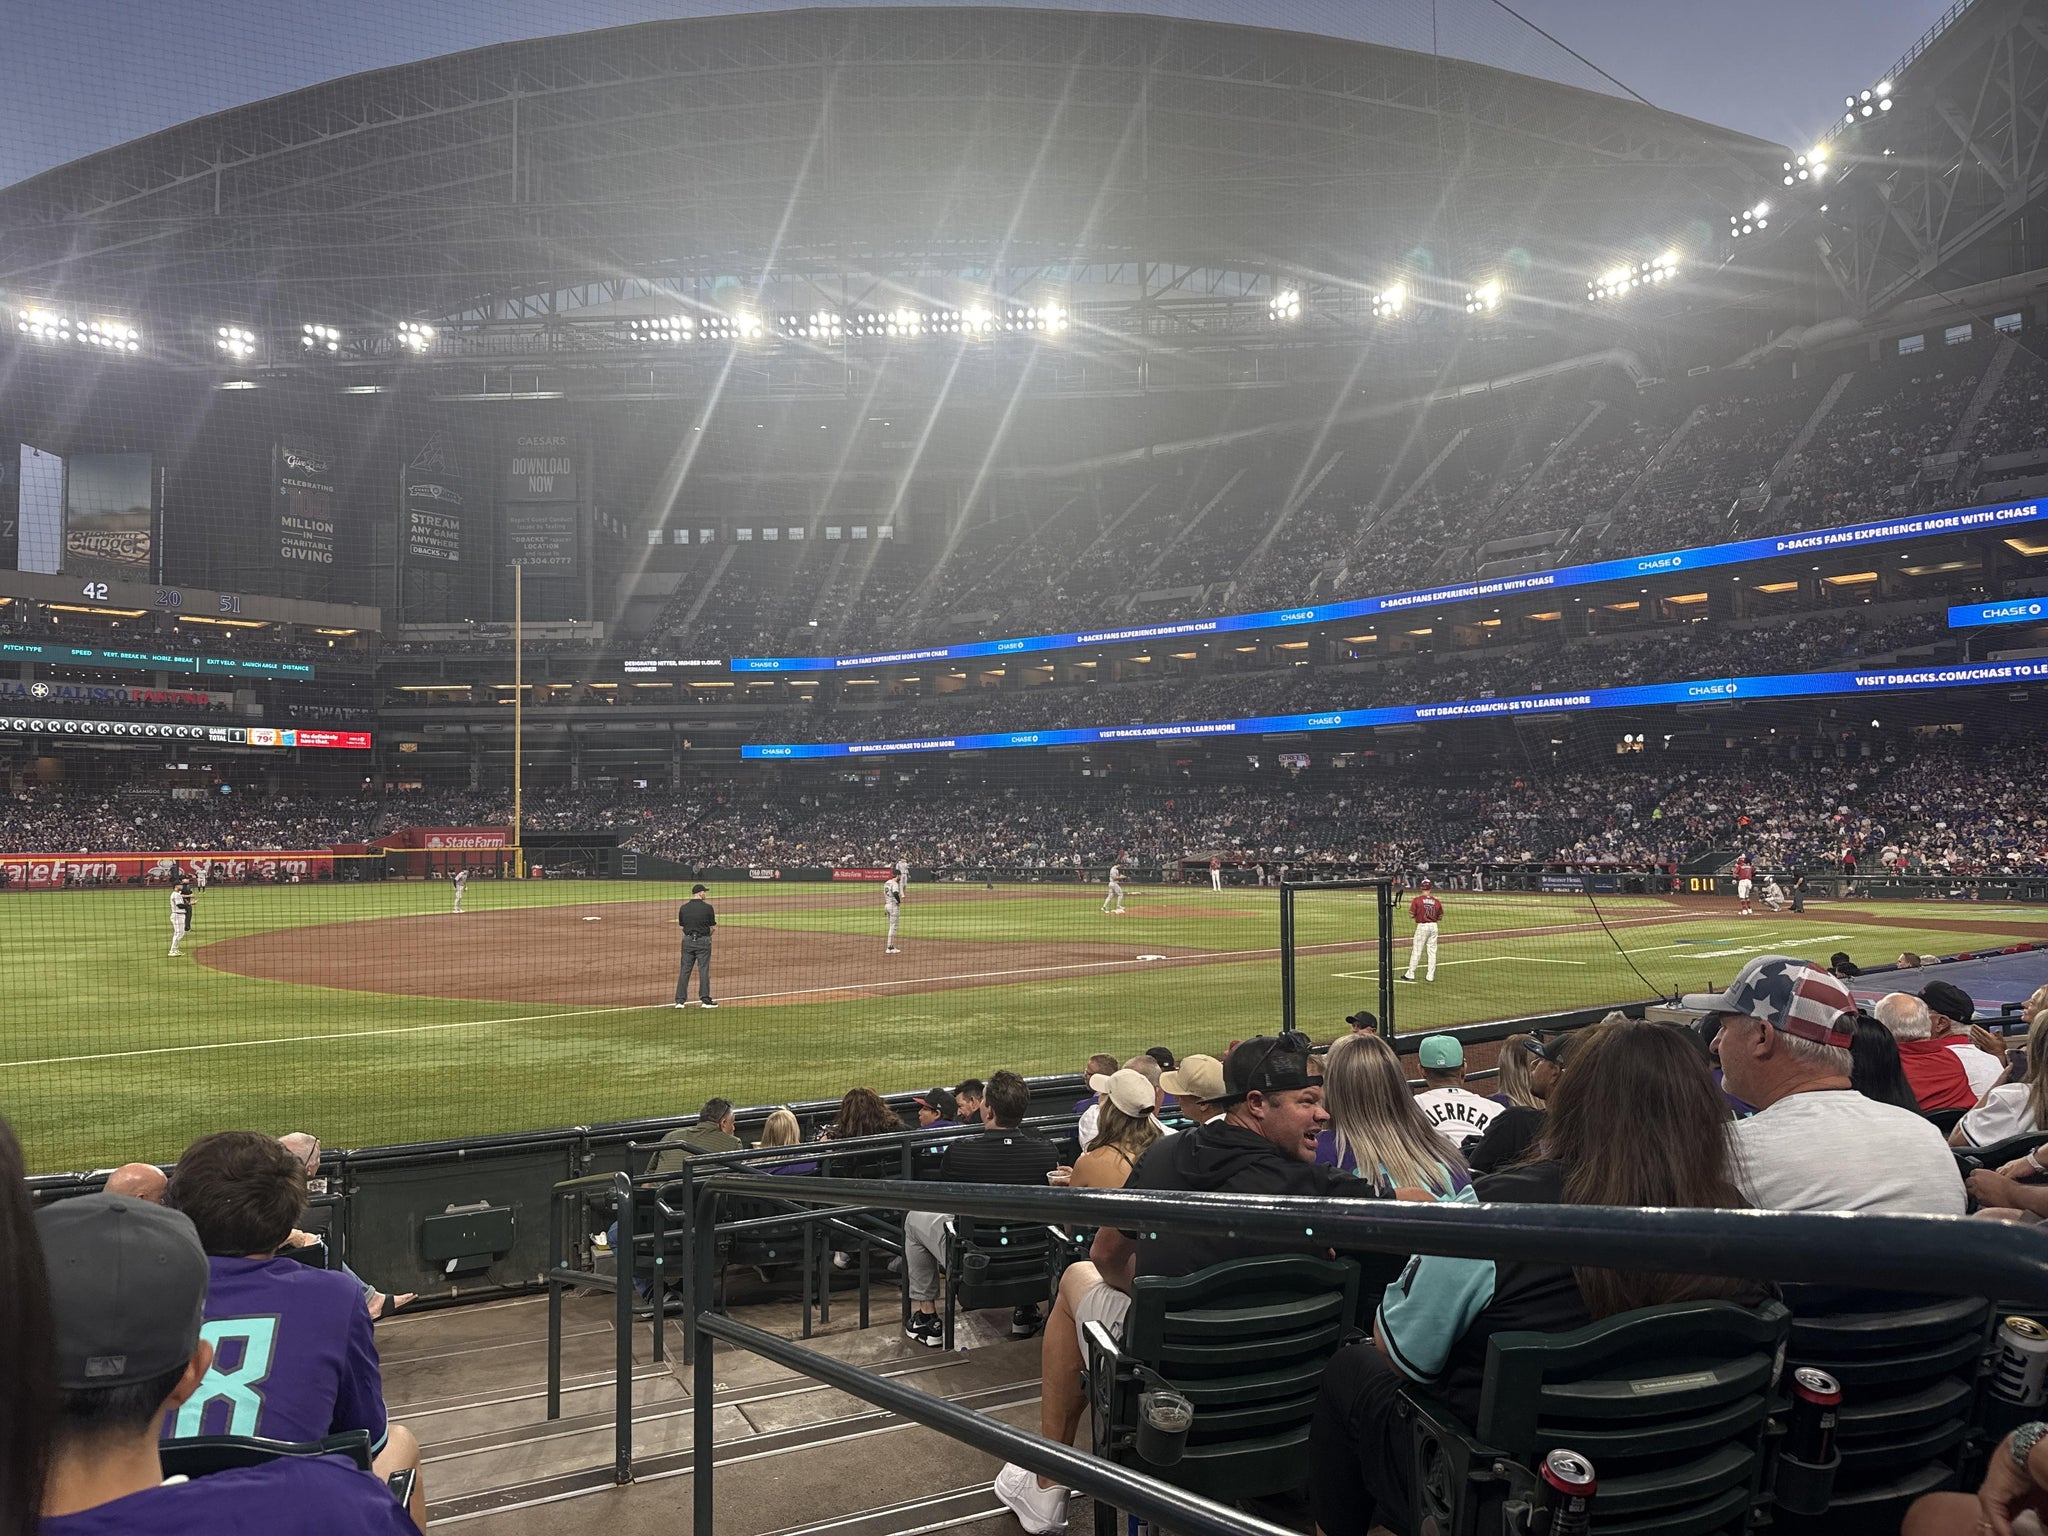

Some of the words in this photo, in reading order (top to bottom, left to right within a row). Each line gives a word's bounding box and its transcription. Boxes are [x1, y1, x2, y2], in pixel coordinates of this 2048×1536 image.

[518, 437, 567, 446] CAESARS
[512, 457, 571, 475] DOWNLOAD
[282, 478, 334, 492] CELEBRATING
[528, 475, 554, 493] NOW
[281, 516, 334, 533] MILLION
[411, 512, 460, 530] STREAM
[411, 524, 432, 535] ANY
[433, 529, 459, 540] GAME
[1777, 536, 1823, 551] D-BACKS
[1824, 531, 1854, 546] FANS
[1854, 521, 1923, 541] EXPERIENCE
[1924, 517, 1960, 531] MORE
[1961, 511, 1995, 525] WITH
[1996, 505, 2039, 520] CHASE
[303, 531, 314, 540] IN
[411, 534, 460, 549] ANYWHERE
[71, 532, 142, 558] Slugger
[281, 538, 334, 551] CHARITABLE
[281, 546, 334, 564] GIVING
[511, 557, 572, 565] 623.304.0777
[1638, 558, 1671, 570] CHASE
[82, 582, 108, 600] 42
[1380, 597, 1412, 609] D-BACKS
[1412, 593, 1433, 605] FANS
[1433, 587, 1479, 600] EXPERIENCE
[1479, 583, 1503, 595] MORE
[1503, 580, 1526, 592] WITH
[1526, 576, 1554, 588] CHASE
[155, 589, 182, 607] 20
[219, 595, 241, 613] 51
[1281, 612, 1306, 622] CHASE
[1983, 606, 2027, 618] CHASE
[1077, 633, 1103, 643] D-BACKS
[1103, 630, 1120, 640] FANS
[1120, 627, 1157, 639] EXPERIENCE
[1157, 624, 1177, 634] MORE
[1177, 622, 1195, 633] WITH
[1194, 621, 1217, 631] CHASE
[3, 643, 24, 652] PITCH
[25, 644, 42, 653] TYPE
[71, 648, 93, 657] SPEED
[997, 643, 1018, 651] CHASE
[103, 651, 120, 659] VERT.
[120, 652, 139, 660] BREAK
[139, 653, 148, 661] IN.
[174, 656, 194, 664] BREAK
[207, 658, 220, 666] EXIT
[220, 659, 237, 667] VELO.
[836, 658, 859, 667] D-BACKS
[859, 656, 872, 665] FANS
[872, 654, 901, 664] EXPERIENCE
[901, 652, 917, 661] MORE
[917, 651, 931, 660] WITH
[931, 649, 949, 658] CHASE
[261, 662, 278, 670] ANGLE
[282, 664, 309, 672] DISTANCE
[1855, 675, 1885, 686] VISIT
[1887, 667, 2012, 684] DBACKS.COM/CHASE
[2013, 665, 2031, 676] TO
[2, 681, 27, 696] LA
[53, 684, 128, 702] JALISCO
[1688, 685, 1724, 696] CHASE
[1415, 708, 1436, 717] VISIT
[1437, 702, 1519, 715] DBACKS.COM/CHASE
[1520, 700, 1532, 709] TO
[1533, 698, 1564, 709] LEARN
[1563, 696, 1590, 706] MORE
[1308, 716, 1334, 726] CHASE
[234, 731, 240, 741] 1
[1116, 726, 1182, 738] DBACKS.COM/CHASE
[1182, 726, 1191, 734] TO
[1191, 724, 1215, 733] LEARN
[1215, 723, 1236, 732] MORE
[209, 734, 228, 742] TOTAL
[1011, 736, 1032, 744] CHASE
[848, 745, 862, 753] VISIT
[921, 741, 939, 749] LEARN
[939, 740, 955, 748] MORE
